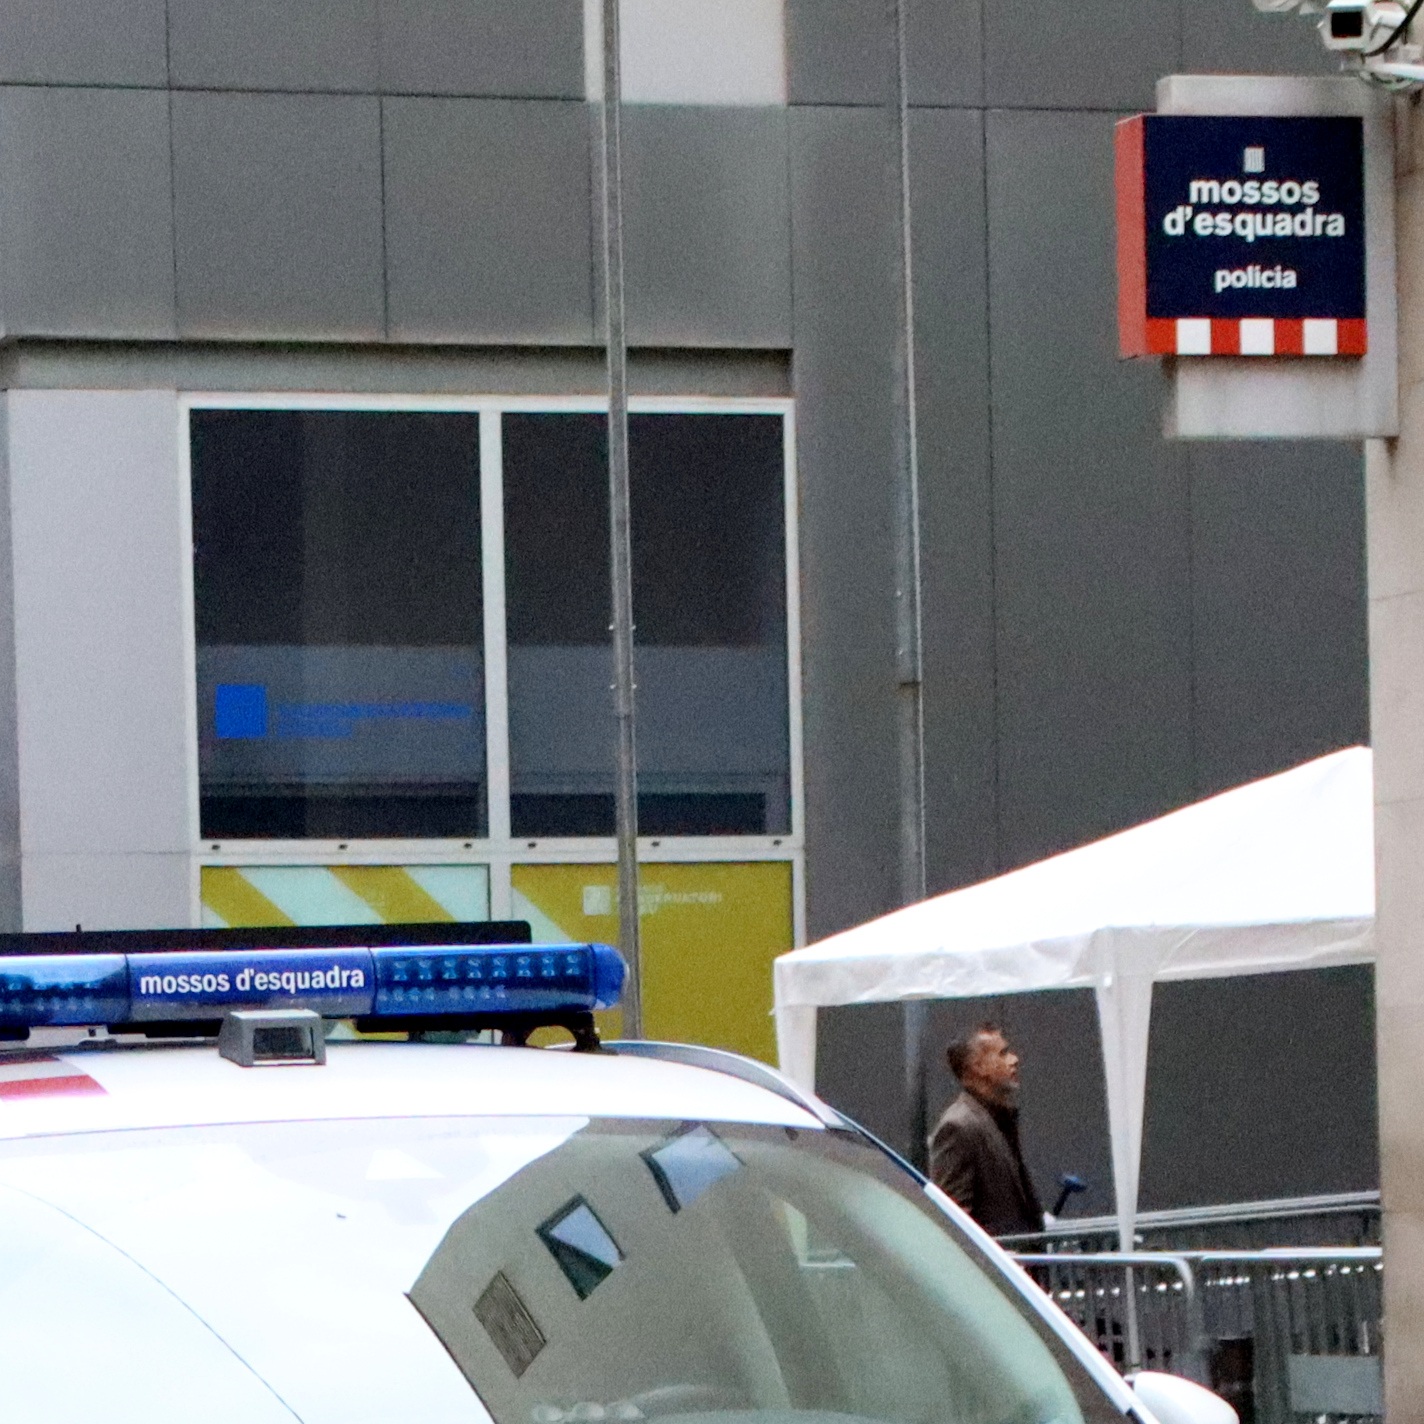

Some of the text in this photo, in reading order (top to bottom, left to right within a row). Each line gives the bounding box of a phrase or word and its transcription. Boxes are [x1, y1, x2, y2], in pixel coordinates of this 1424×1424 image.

[1189, 179, 1320, 205] mossos
[1163, 206, 1346, 242] d'esquadra
[1215, 266, 1297, 292] policia
[140, 965, 365, 995] mossos d'esquadra
